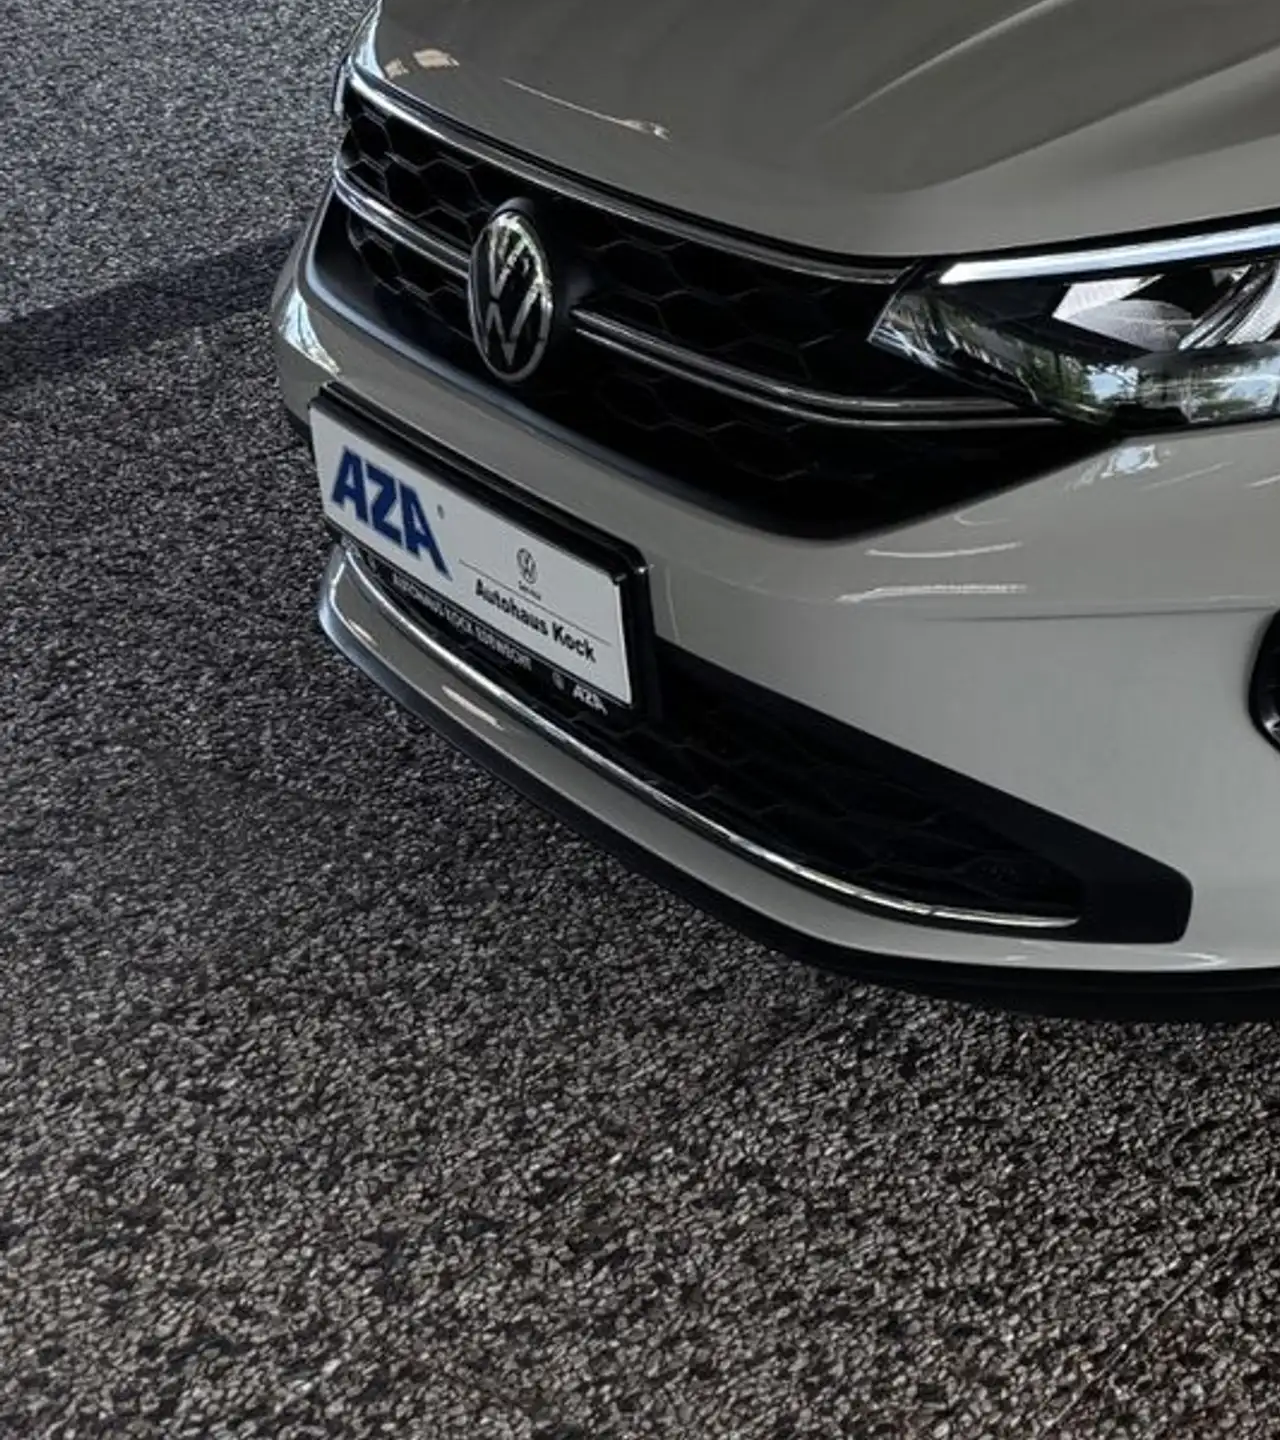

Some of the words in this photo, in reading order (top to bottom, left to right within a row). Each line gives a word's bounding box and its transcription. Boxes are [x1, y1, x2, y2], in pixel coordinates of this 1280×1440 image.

[332, 446, 453, 581] AZA
[475, 578, 549, 636] Autohaus
[552, 621, 597, 664] Kock
